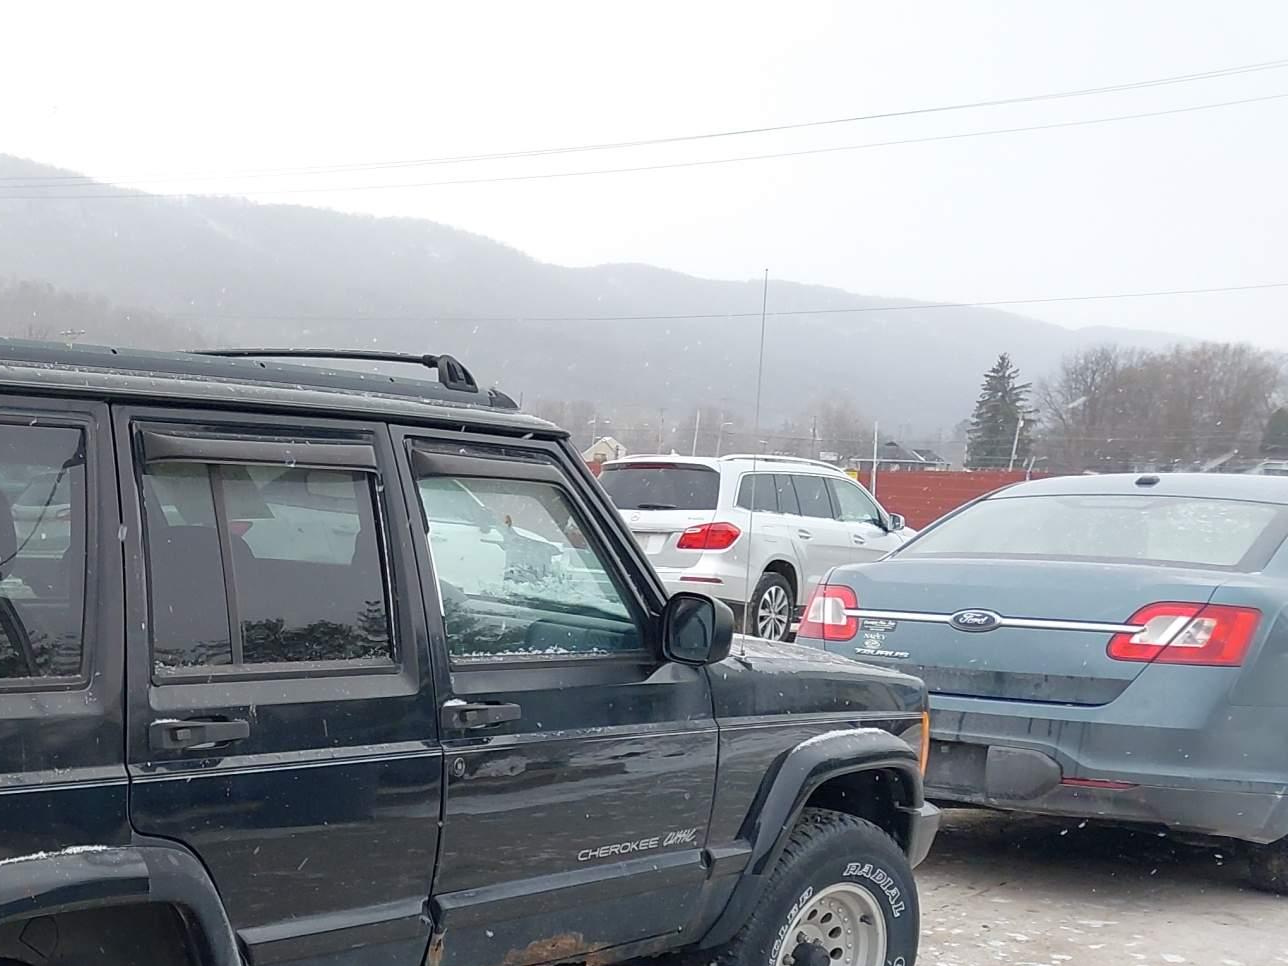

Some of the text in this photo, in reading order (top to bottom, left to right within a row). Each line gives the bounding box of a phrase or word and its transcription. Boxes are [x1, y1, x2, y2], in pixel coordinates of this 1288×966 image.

[959, 612, 989, 625] Ford
[854, 647, 911, 658] TAURUS
[577, 836, 660, 861] CHEROKEE
[843, 862, 907, 918] RADIAL
